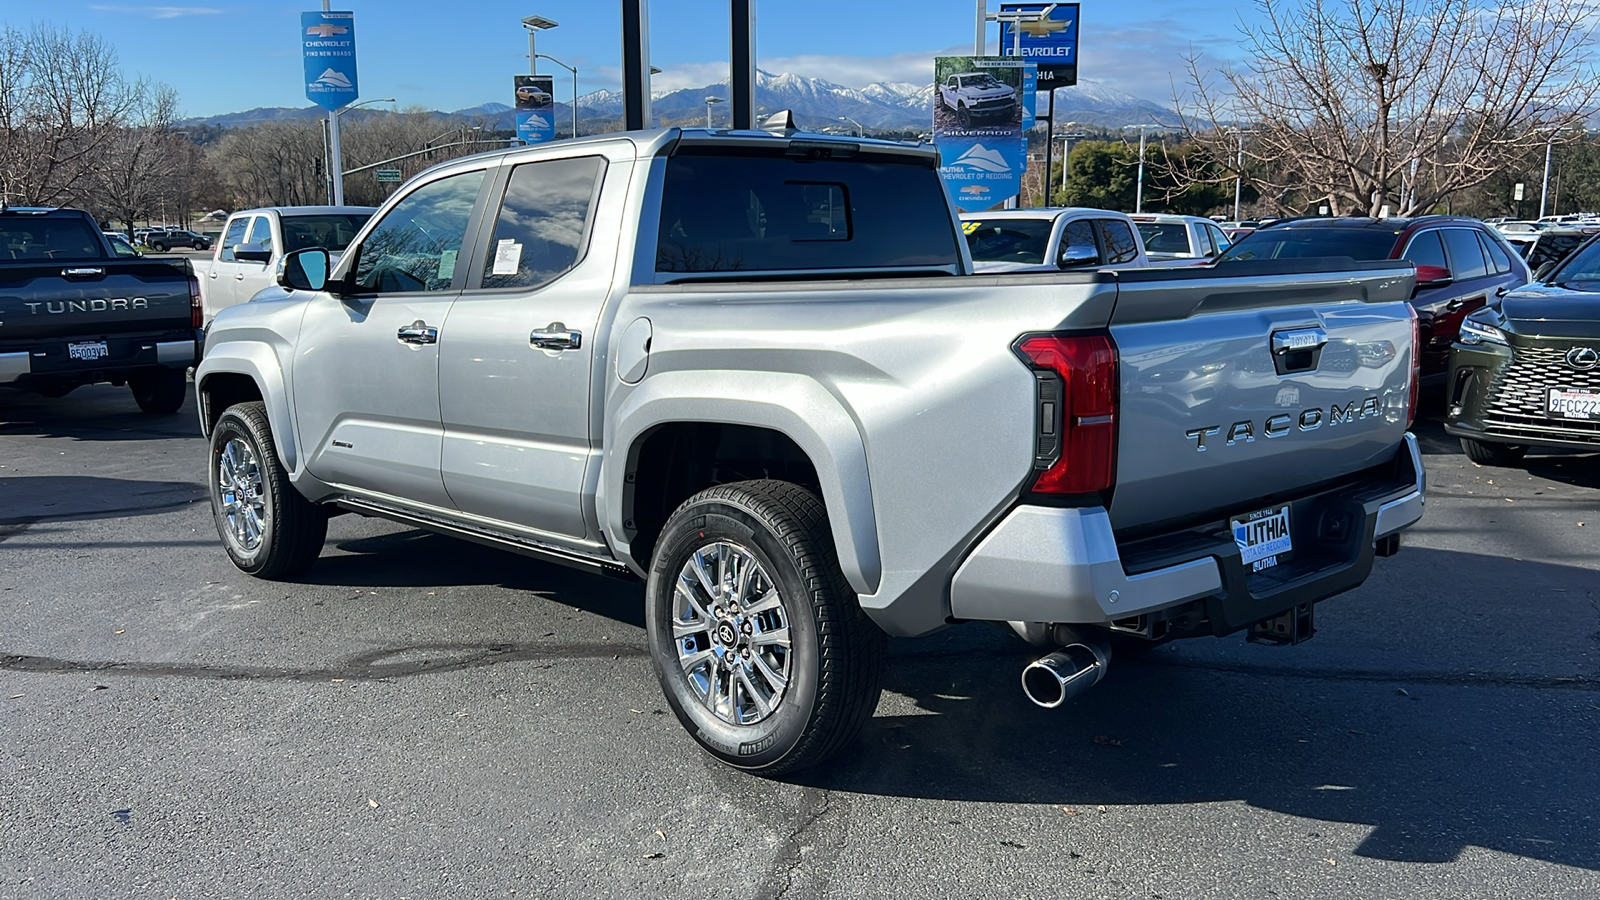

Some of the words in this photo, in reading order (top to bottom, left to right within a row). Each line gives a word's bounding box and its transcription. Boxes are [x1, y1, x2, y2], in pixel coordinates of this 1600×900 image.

[1006, 47, 1071, 56] CEVROLET
[24, 297, 148, 314] TUNDRA
[1290, 335, 1316, 347] TOYOTA
[1185, 396, 1380, 452] TACOMA
[1250, 510, 1262, 520] SINCE
[1263, 508, 1273, 517] 1946
[1246, 516, 1288, 547] LITHIA
[1243, 548, 1257, 560] YOTA
[1258, 544, 1265, 554] OF
[1266, 537, 1290, 552] REDDING
[1258, 556, 1278, 570] LITHIA
